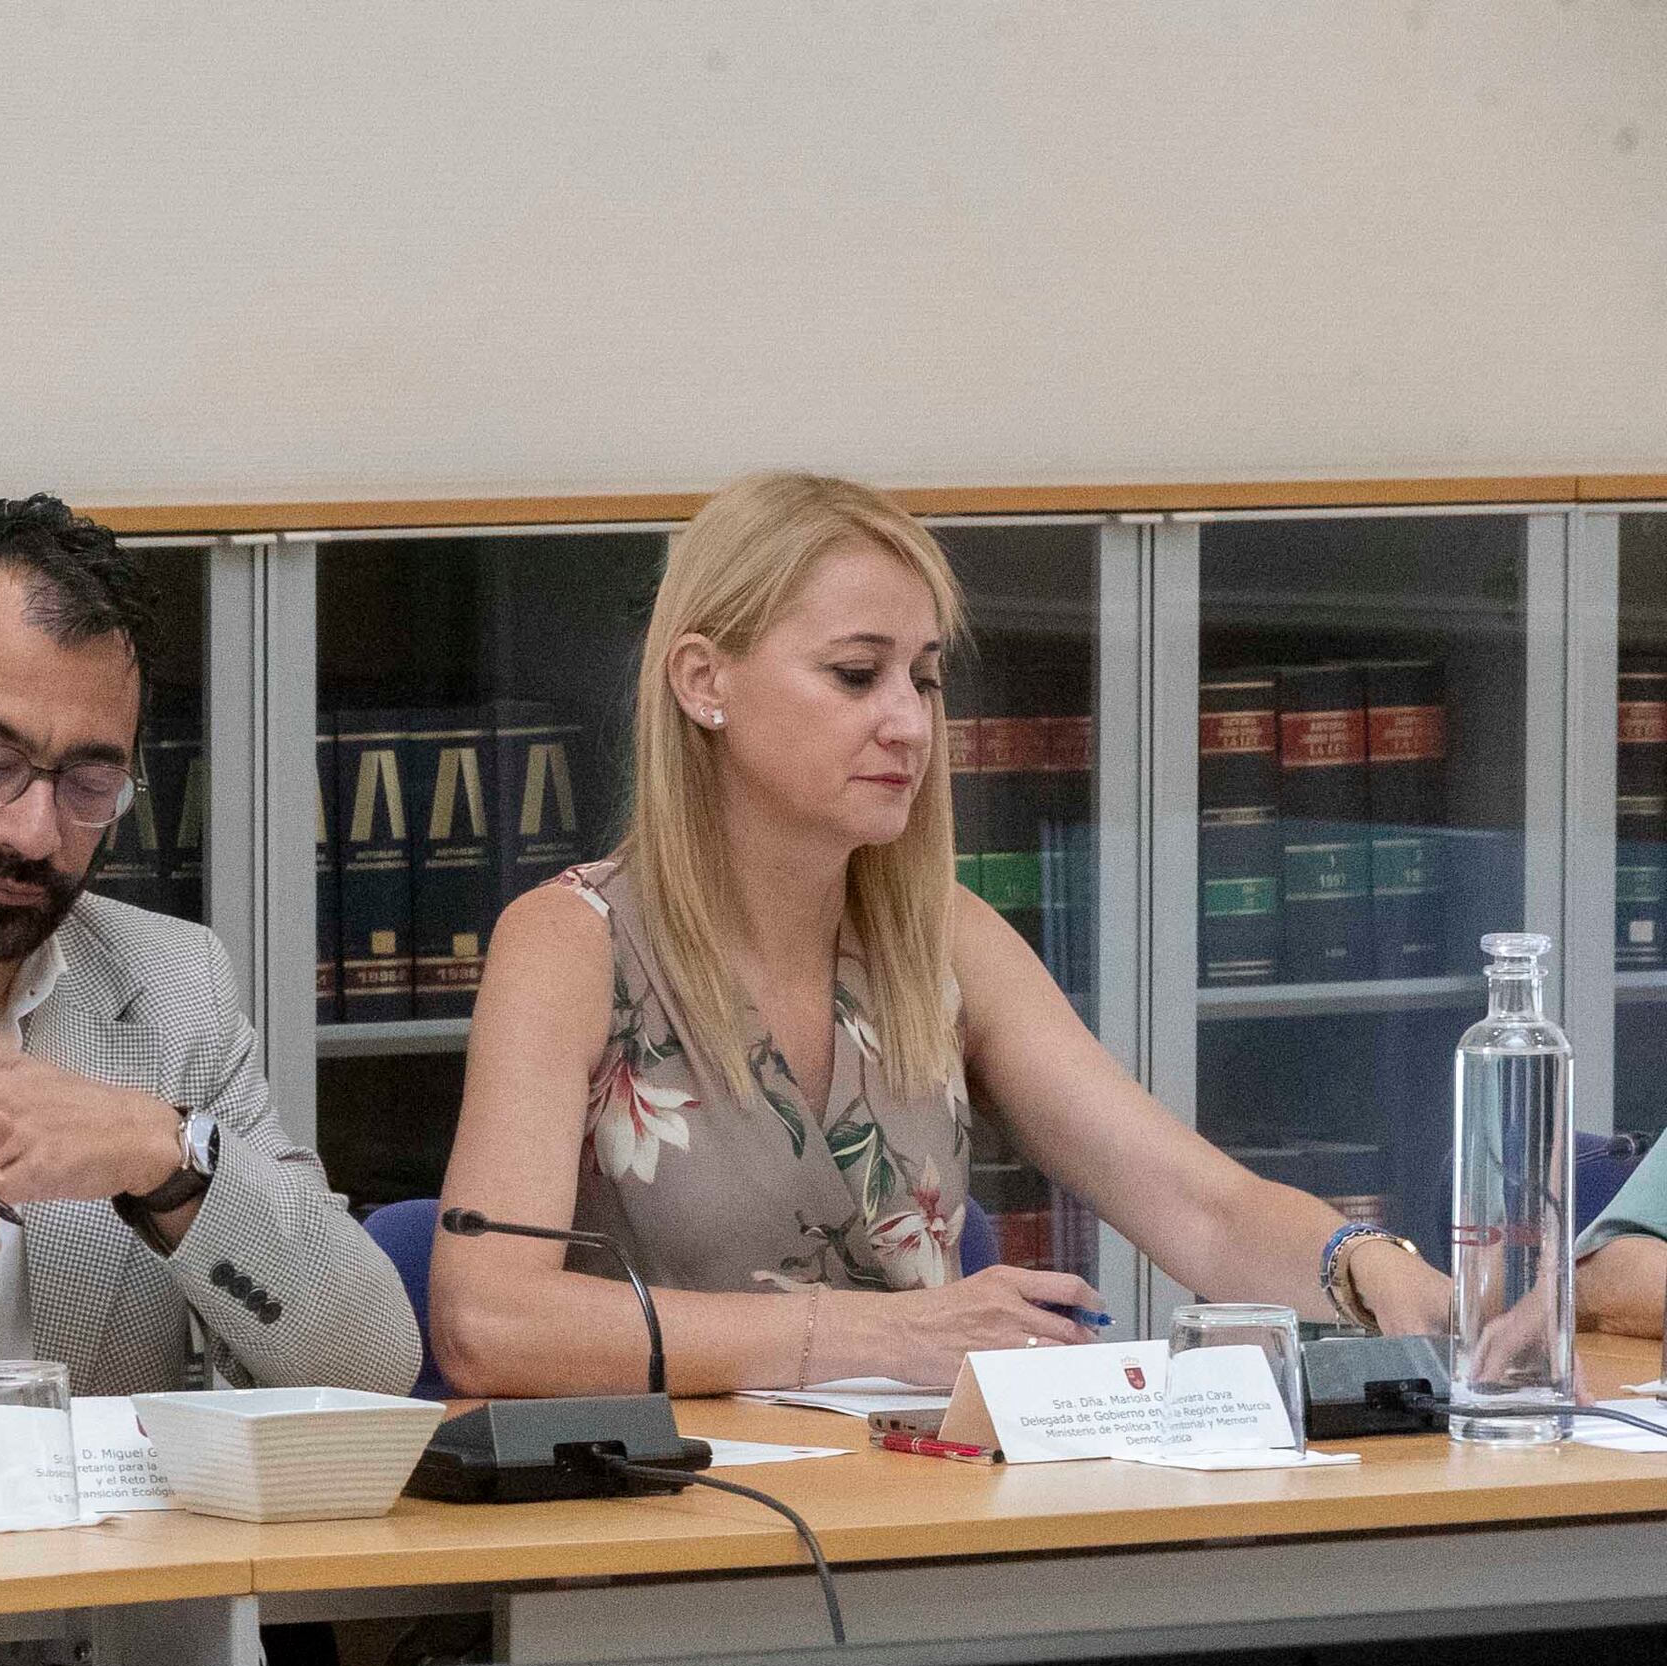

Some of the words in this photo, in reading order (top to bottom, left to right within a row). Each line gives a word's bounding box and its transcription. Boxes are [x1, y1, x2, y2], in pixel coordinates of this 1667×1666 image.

[1052, 1399, 1077, 1410] Sra.
[1079, 1397, 1107, 1408] Dña.
[1109, 1393, 1151, 1405] Mariola
[1207, 1390, 1233, 1401] Cava
[1020, 1414, 1074, 1427] Delegada
[1077, 1412, 1091, 1423] de
[1094, 1408, 1145, 1421] Gobierno
[1148, 1408, 1163, 1418] en
[1183, 1405, 1219, 1418] Región
[1221, 1403, 1235, 1413] de
[1237, 1402, 1272, 1412] Murcia
[1046, 1426, 1097, 1438] Ministerio
[1099, 1424, 1112, 1435] de
[81, 1449, 97, 1460] D.
[101, 1448, 144, 1461] Miguel
[147, 1447, 159, 1458] G
[118, 1462, 144, 1473] para
[95, 1477, 102, 1486] y
[106, 1475, 117, 1485] el
[120, 1475, 146, 1485] Reto
